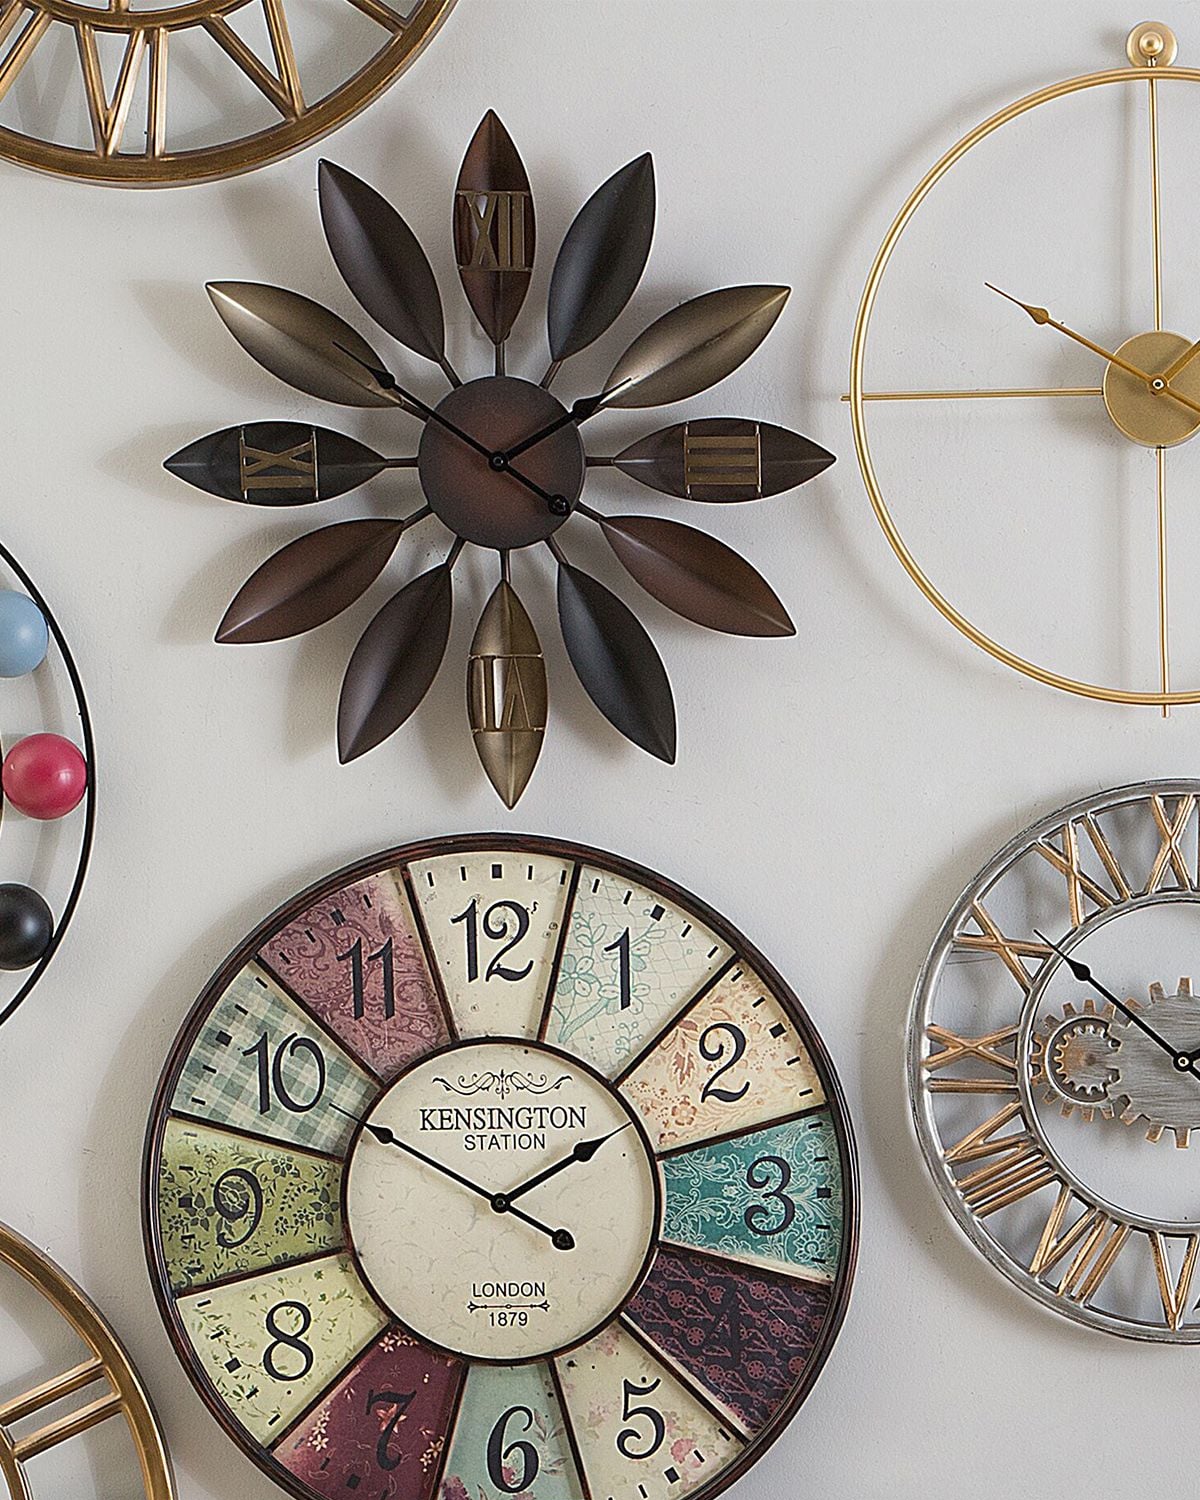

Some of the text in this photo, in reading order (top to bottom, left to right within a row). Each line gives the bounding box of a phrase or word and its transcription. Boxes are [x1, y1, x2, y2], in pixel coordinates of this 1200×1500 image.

[464, 190, 526, 271] XII
[240, 441, 318, 492] IX
[684, 433, 761, 487] III
[1036, 812, 1132, 927] XI
[336, 936, 396, 1021] 11
[451, 899, 535, 983] 12
[603, 926, 633, 1010] 1
[953, 901, 1059, 994] X
[243, 1032, 326, 1115] 10
[699, 1022, 752, 1103] 2
[925, 1025, 1021, 1095] IX
[419, 1106, 587, 1131] KENSINGTON
[464, 1133, 546, 1151] STATION
[943, 1100, 1059, 1219] VIII
[216, 1168, 265, 1248] 9
[746, 1155, 796, 1237] 3
[1029, 1186, 1133, 1305] VII
[472, 1282, 546, 1298] LONDON
[489, 1311, 529, 1327] 1879
[263, 1300, 313, 1382] 8
[366, 1390, 417, 1471] 7
[486, 1405, 538, 1493] 6
[616, 1375, 665, 1460] 5
